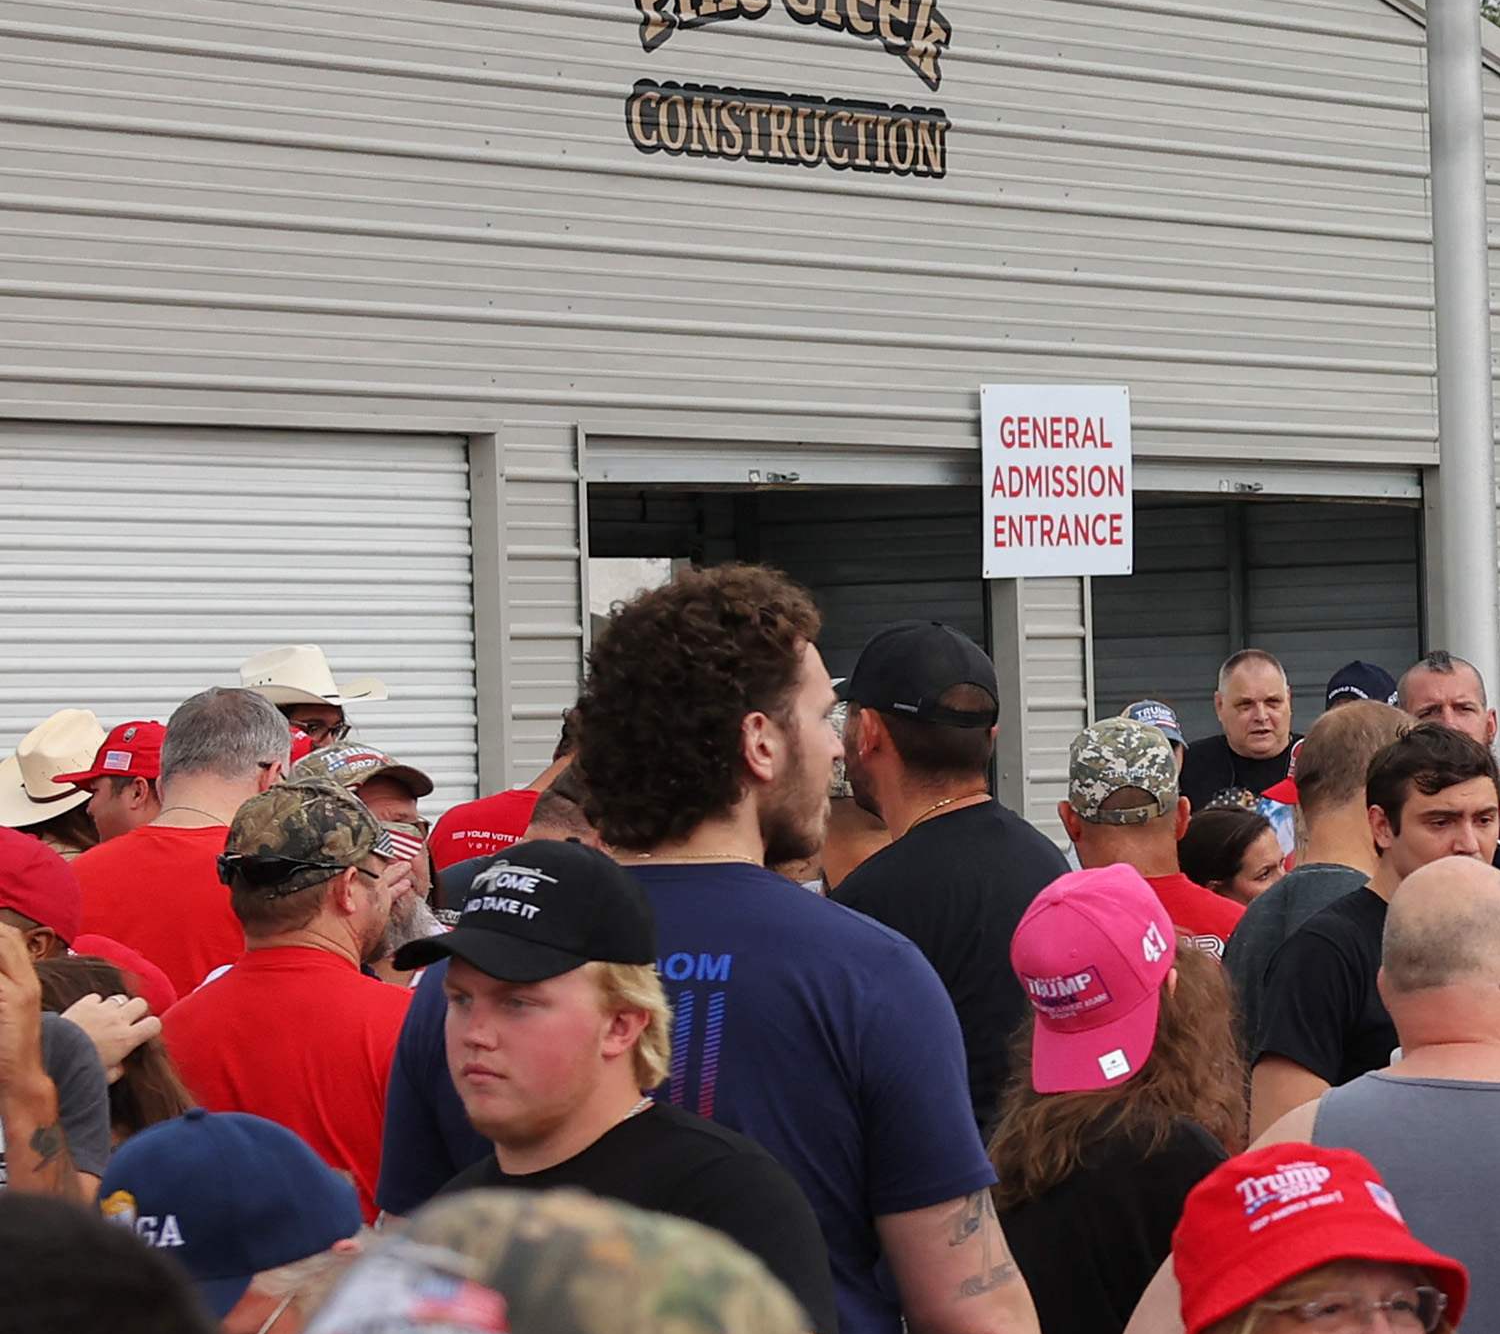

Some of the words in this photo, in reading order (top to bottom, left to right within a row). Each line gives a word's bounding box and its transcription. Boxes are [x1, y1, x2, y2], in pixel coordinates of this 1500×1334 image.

[627, 80, 950, 177] CONSTRUCTION
[999, 415, 1113, 450] GENERAL
[991, 464, 1125, 499] ADMISSION
[993, 512, 1123, 549] ENTRANCE
[466, 830, 490, 839] YOUR
[491, 831, 514, 842] VOTE
[483, 897, 521, 915] TAKE
[521, 902, 541, 920] IT
[1141, 921, 1168, 963] 47
[1027, 973, 1092, 999] TRUMP
[1236, 1166, 1332, 1205] Trump
